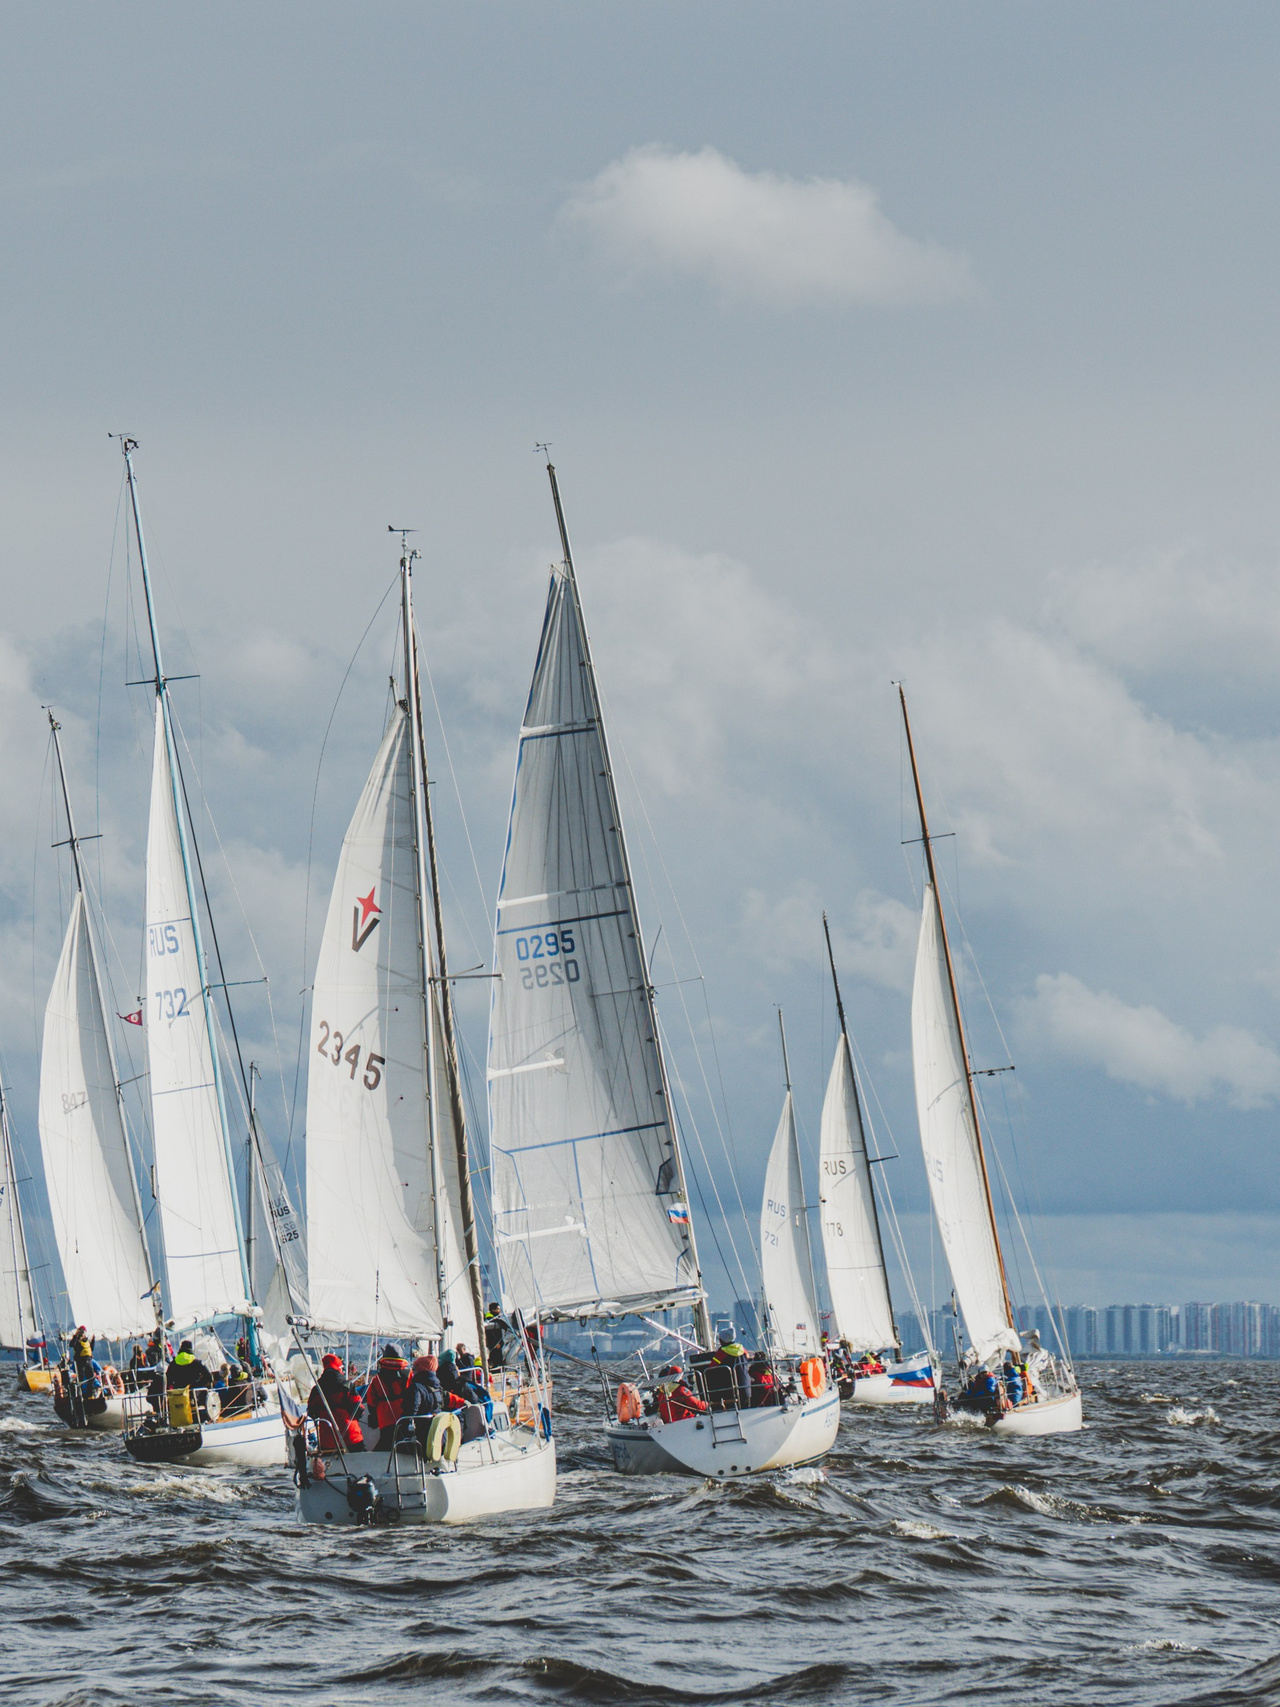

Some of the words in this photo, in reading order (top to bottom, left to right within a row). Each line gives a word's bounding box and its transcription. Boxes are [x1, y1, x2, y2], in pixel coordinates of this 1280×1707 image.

[149, 924, 180, 958] RUS
[515, 929, 576, 961] 0295
[155, 987, 190, 1021] 732
[317, 1020, 386, 1091] 2345
[61, 1091, 86, 1113] 847
[823, 1160, 847, 1176] RUS
[0, 1186, 5, 1195] 4
[767, 1199, 787, 1218] RUS
[764, 1230, 779, 1248] 721
